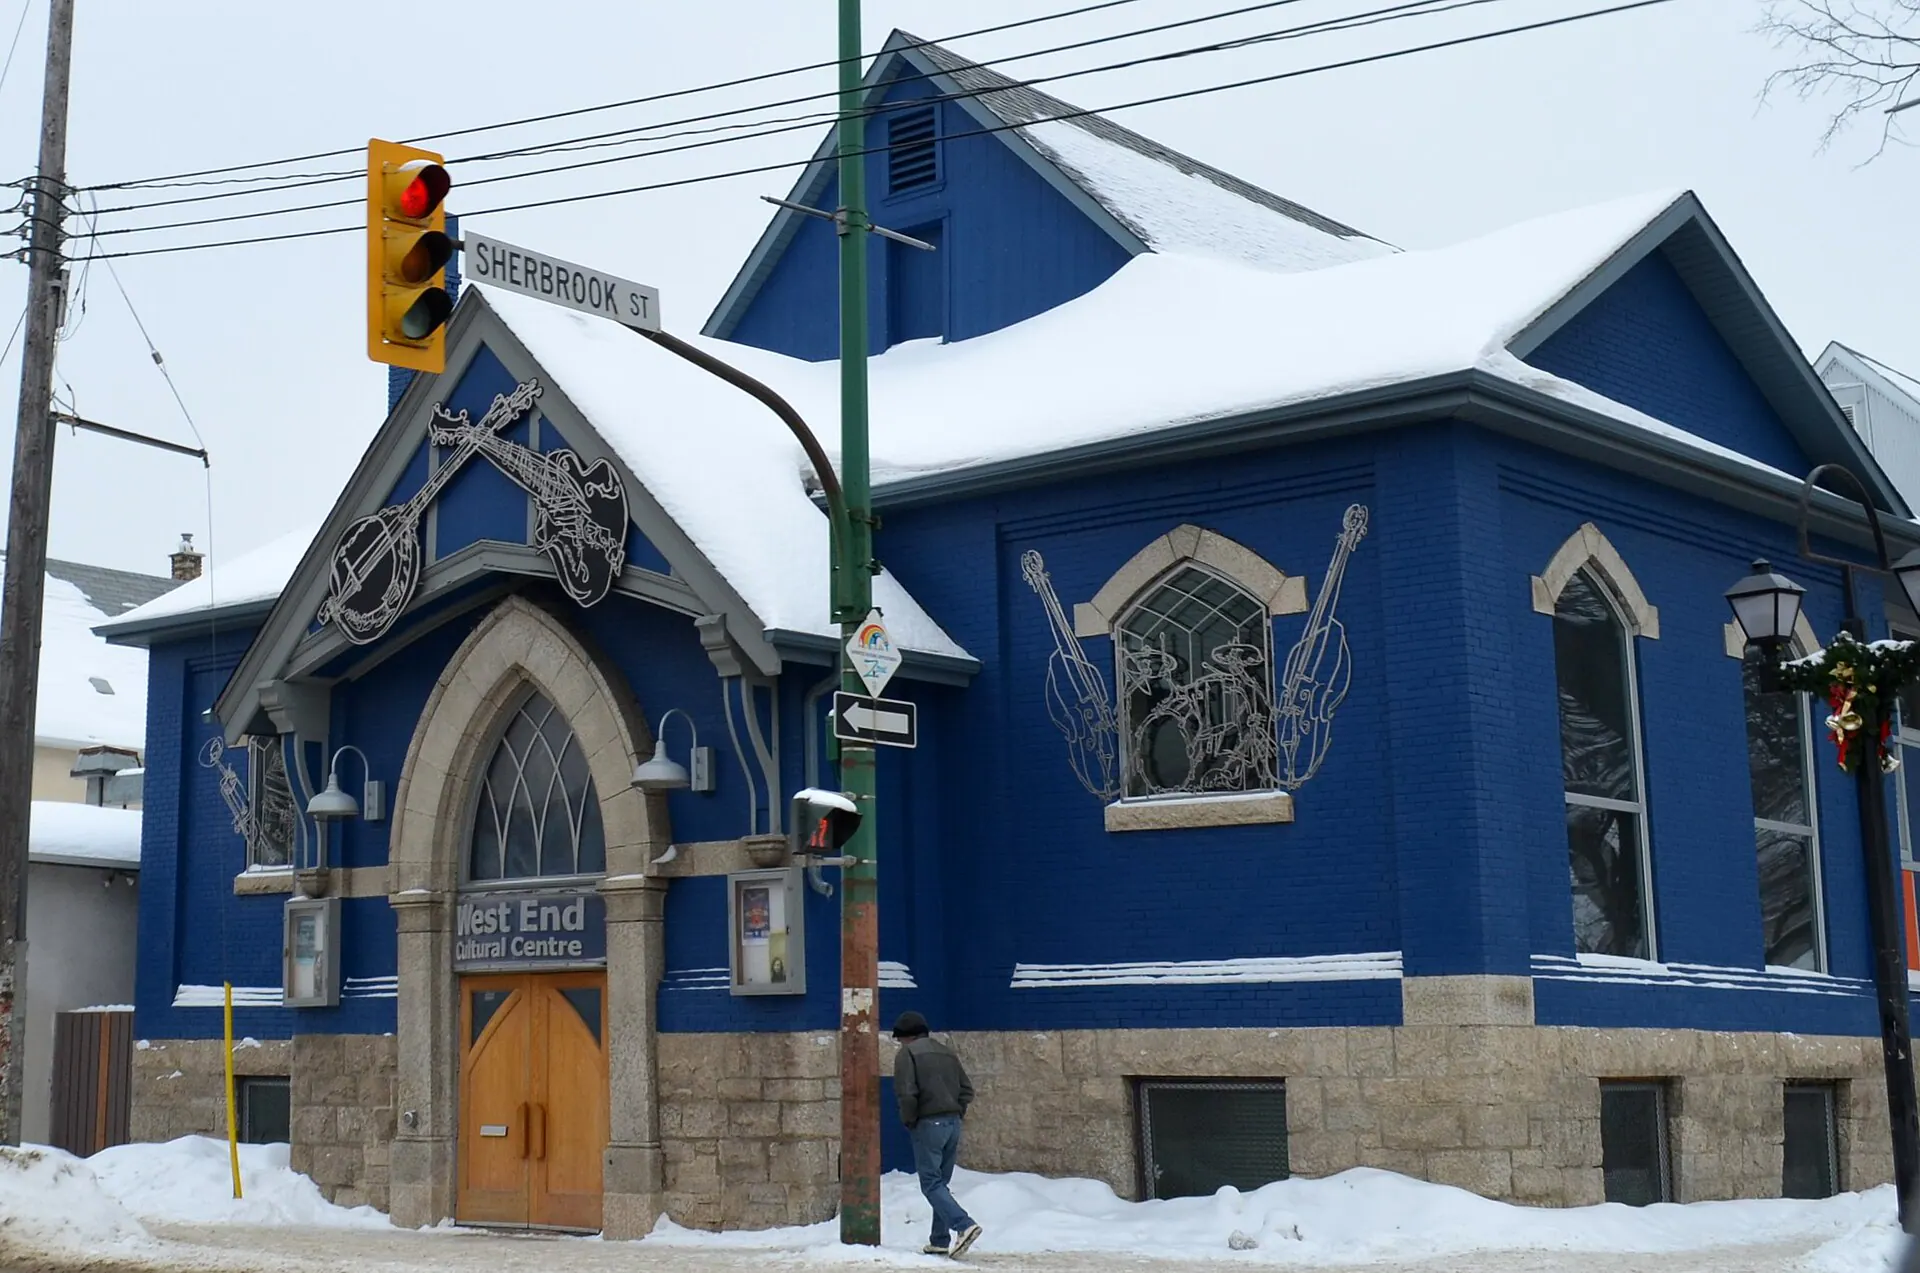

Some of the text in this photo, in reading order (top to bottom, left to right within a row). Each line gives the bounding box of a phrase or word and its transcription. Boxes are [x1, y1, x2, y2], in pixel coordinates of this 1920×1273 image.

[476, 242, 649, 319] SHERBROOK ST
[457, 897, 585, 936] West End
[456, 936, 583, 960] Cultural Centre
